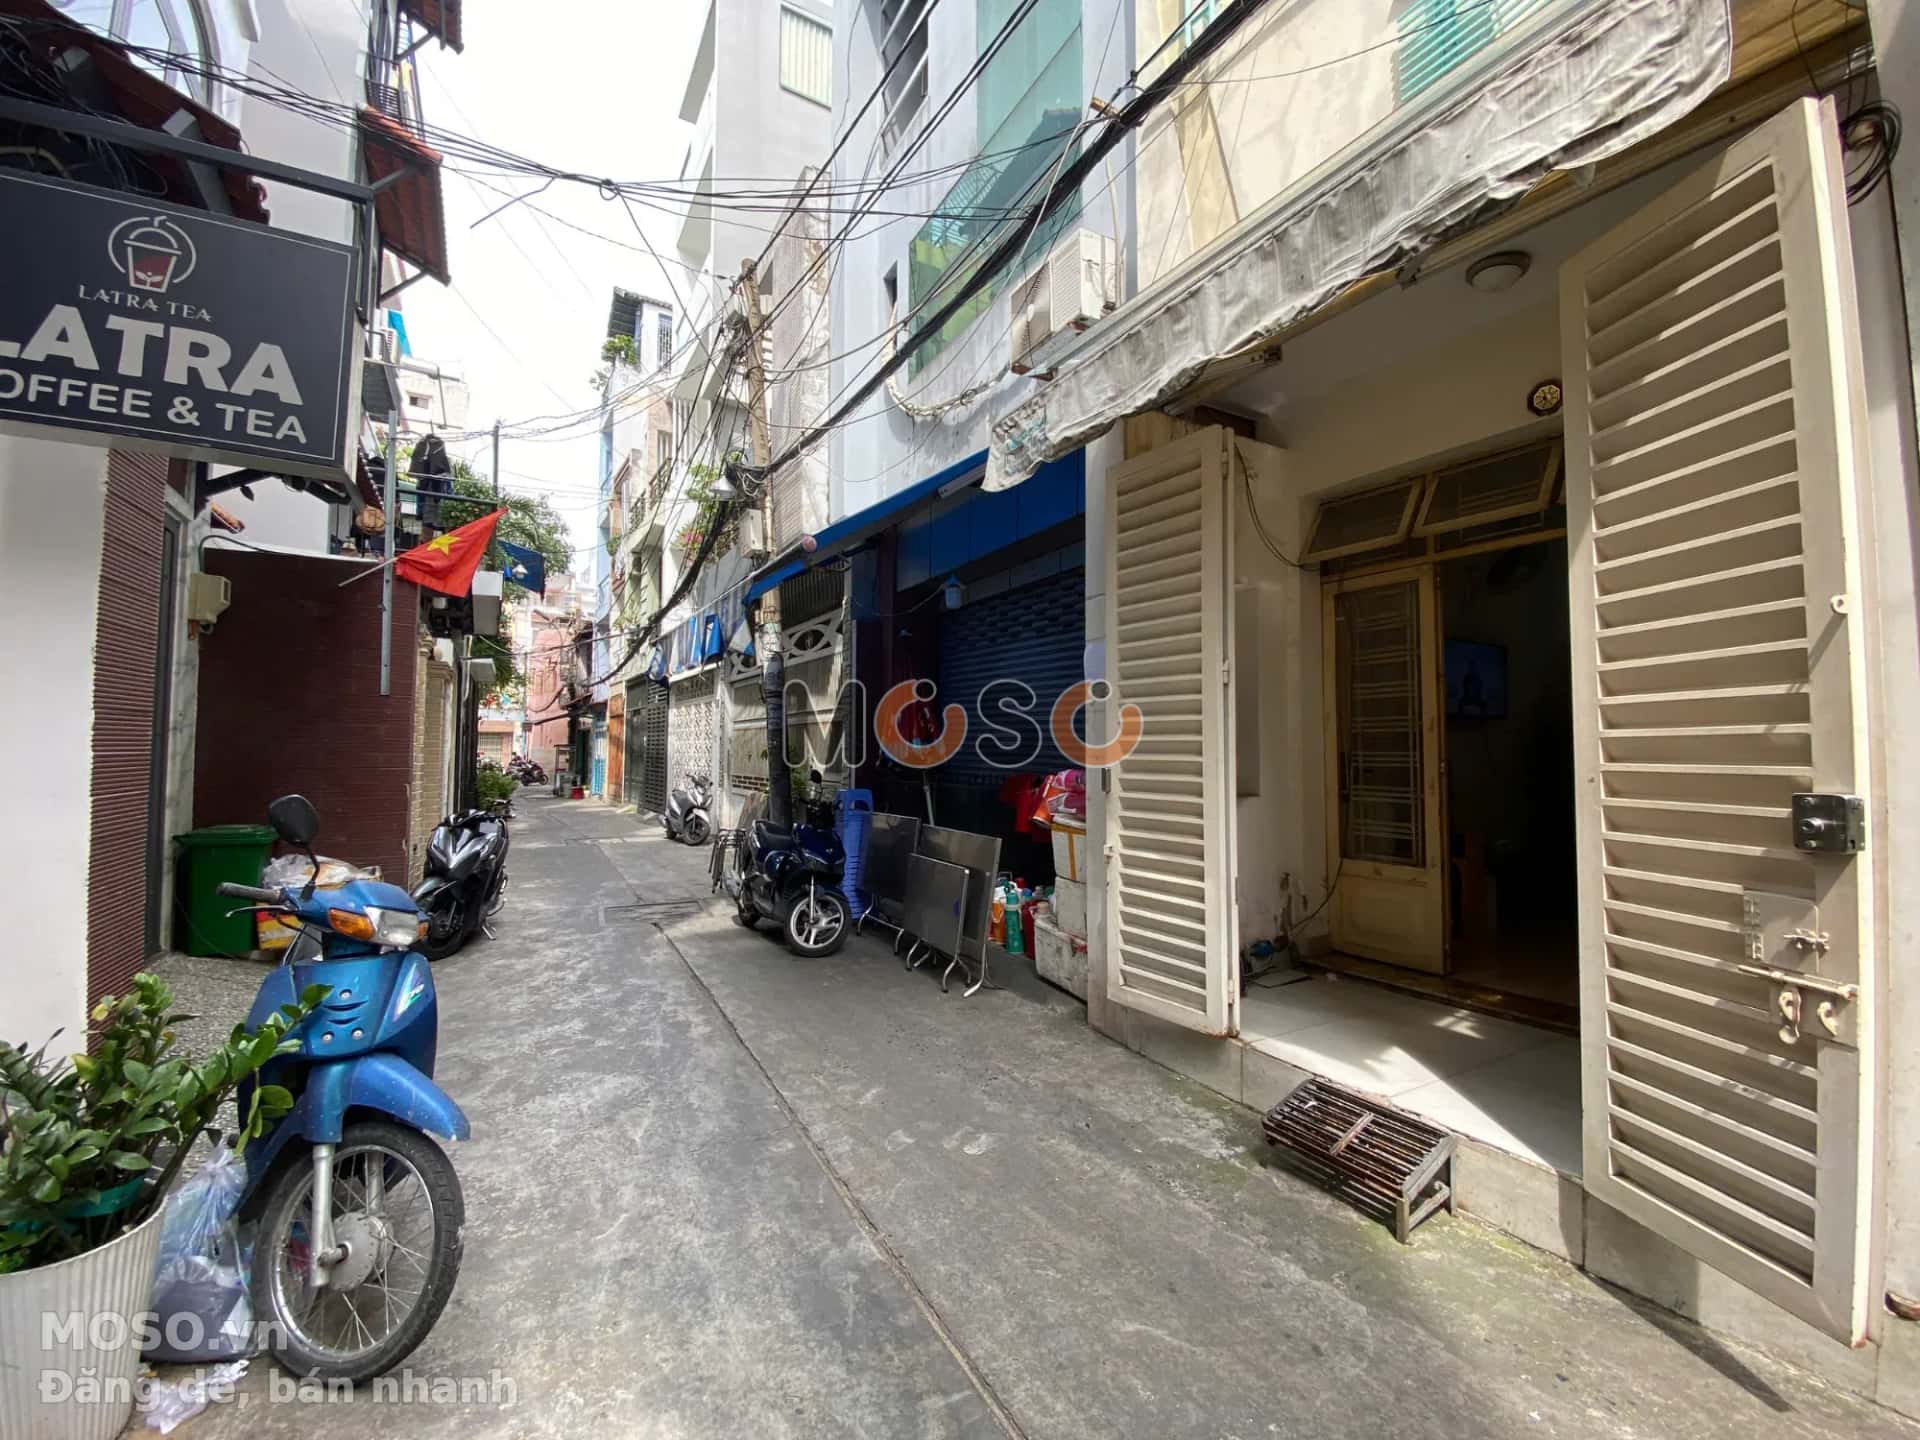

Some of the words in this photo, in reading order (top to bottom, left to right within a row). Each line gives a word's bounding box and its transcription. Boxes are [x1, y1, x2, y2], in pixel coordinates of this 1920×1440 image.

[78, 284, 160, 312] LATRA
[167, 301, 213, 323] TEA
[167, 396, 201, 426] &
[215, 403, 307, 445] TEA
